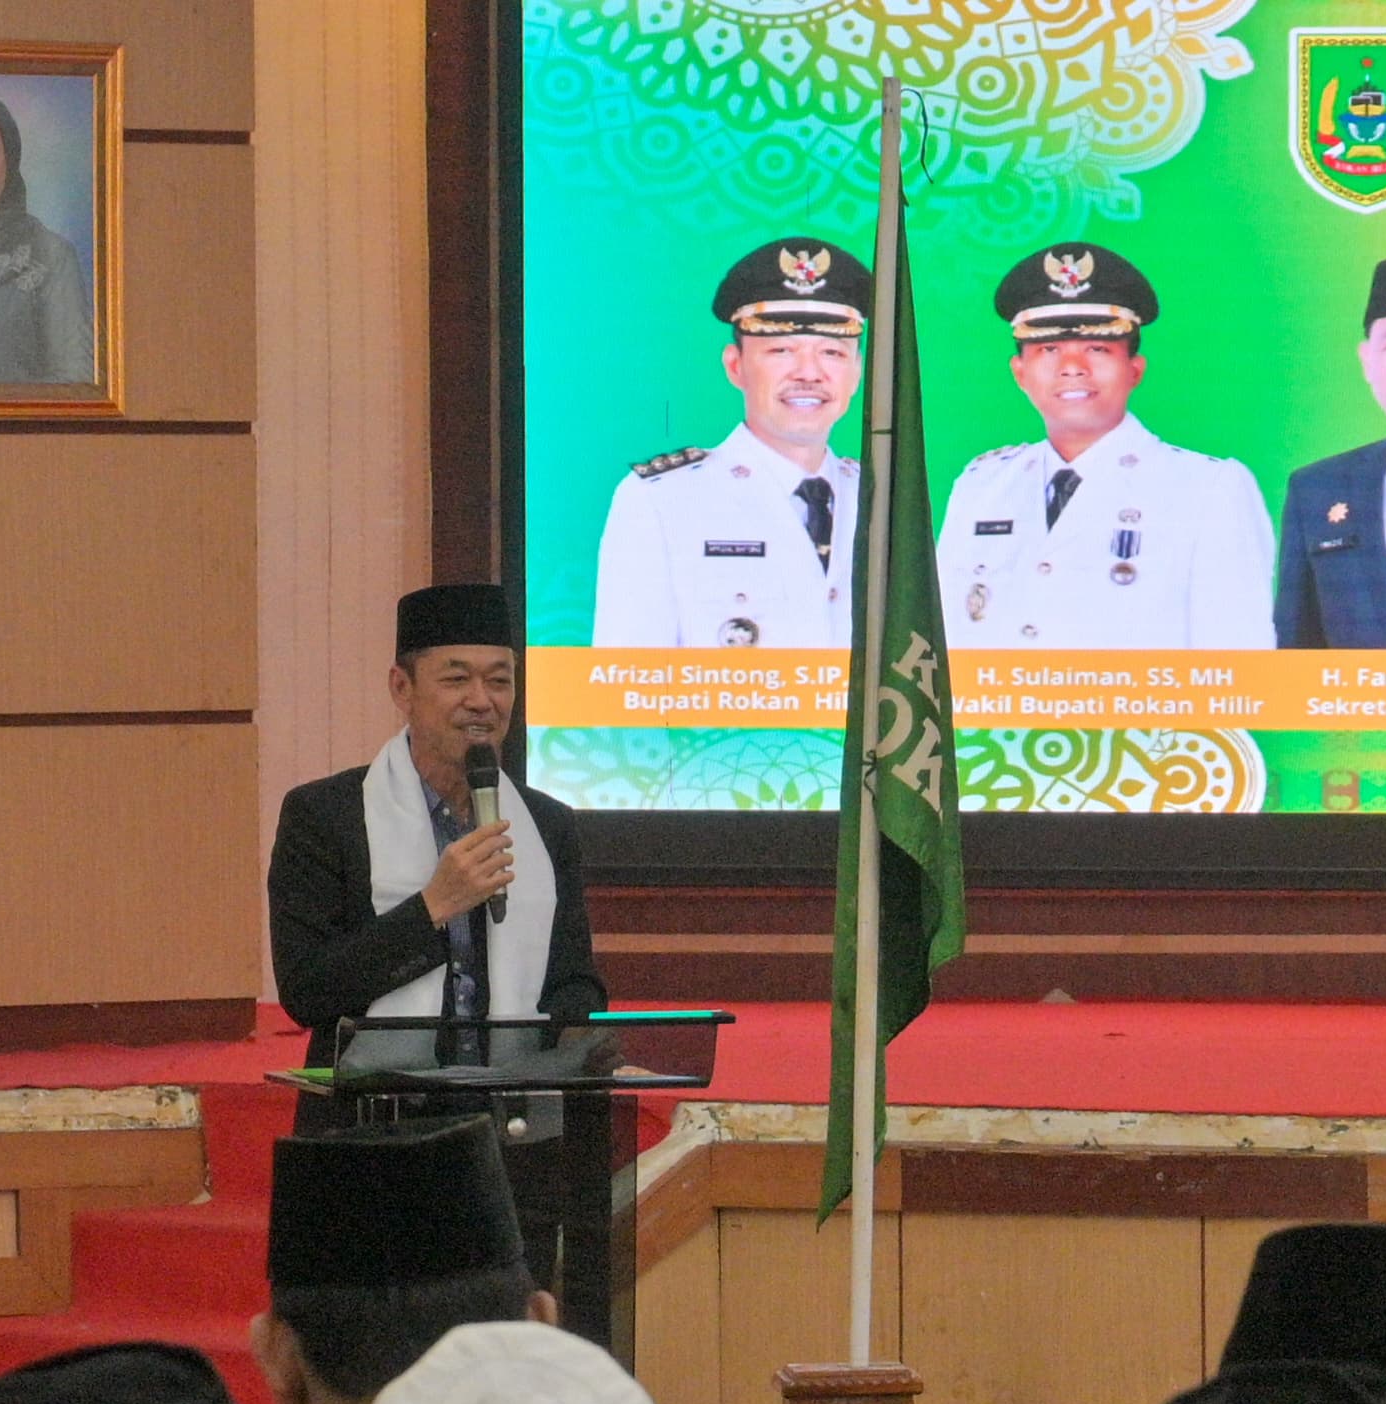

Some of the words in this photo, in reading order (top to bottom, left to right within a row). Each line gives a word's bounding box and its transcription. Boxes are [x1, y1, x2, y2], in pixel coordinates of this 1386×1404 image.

[588, 664, 674, 685] Afrizal
[680, 665, 787, 690] Sintong,
[977, 667, 1004, 686] H.
[1011, 667, 1138, 689] Sulaiman,
[1147, 668, 1182, 690] SS,
[1189, 668, 1234, 687] MH
[1321, 668, 1348, 687] H.
[623, 690, 711, 715] Bupati
[718, 691, 801, 711] Rokan
[1020, 695, 1105, 720] Bupati
[1113, 696, 1194, 716] Rokan
[1208, 696, 1265, 716] Hilir
